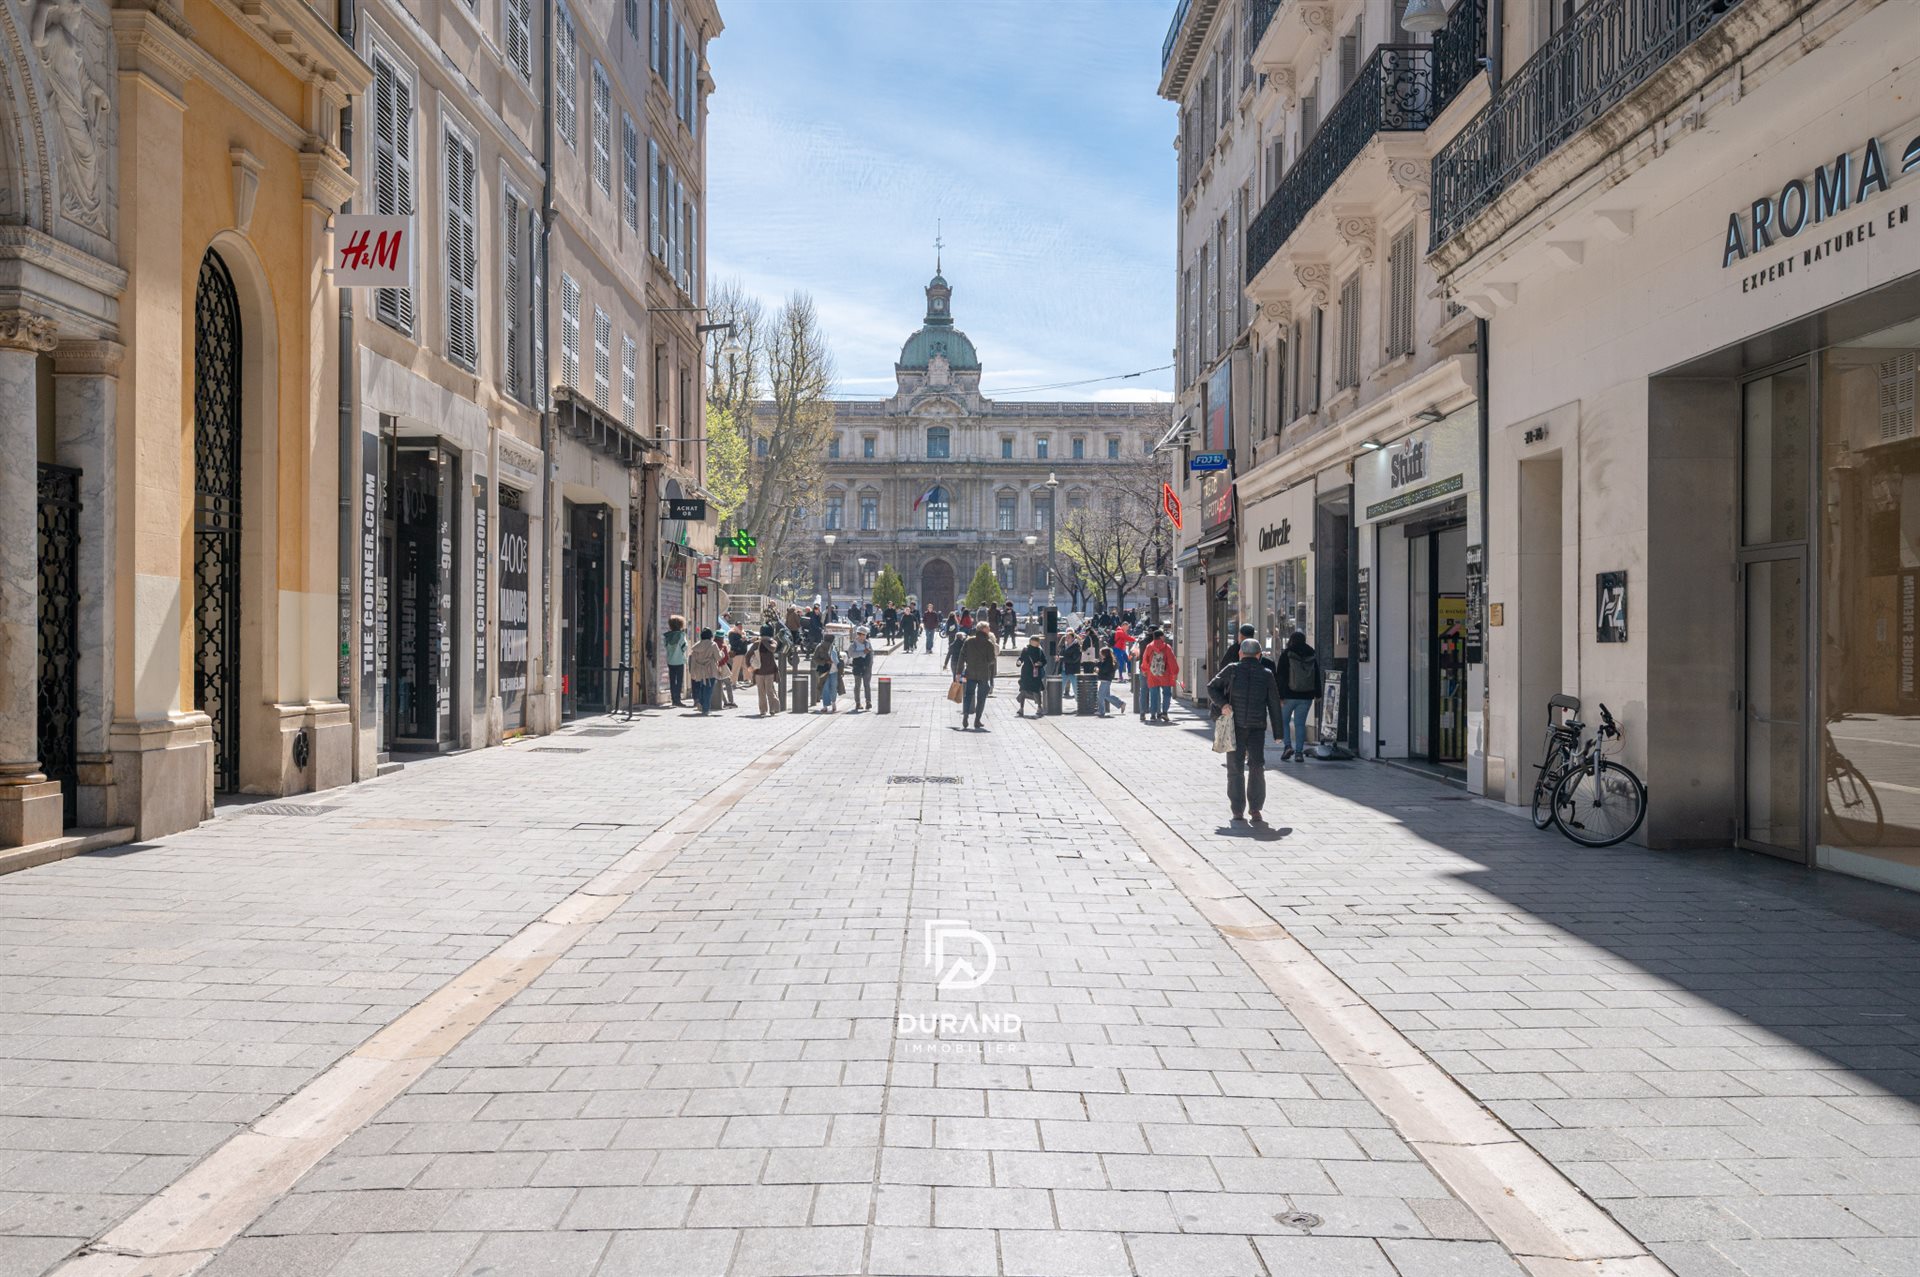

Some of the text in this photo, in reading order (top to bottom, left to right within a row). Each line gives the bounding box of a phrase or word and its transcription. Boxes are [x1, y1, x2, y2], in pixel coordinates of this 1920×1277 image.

[1722, 137, 1891, 268] AROMA
[340, 229, 402, 271] H&M
[1742, 204, 1909, 293] EXPERT NATUREL EN
[1196, 456, 1213, 464] FDJ
[1391, 442, 1424, 489] Stuff
[500, 532, 523, 574] 400
[1259, 518, 1291, 552] Ombrelle
[363, 473, 375, 676] THE CORNER.COM
[476, 508, 486, 672] THE CORNER.COM
[500, 588, 527, 626] MARQUES
[500, 628, 527, 662] PREMIUM
[440, 687, 450, 715] DE
